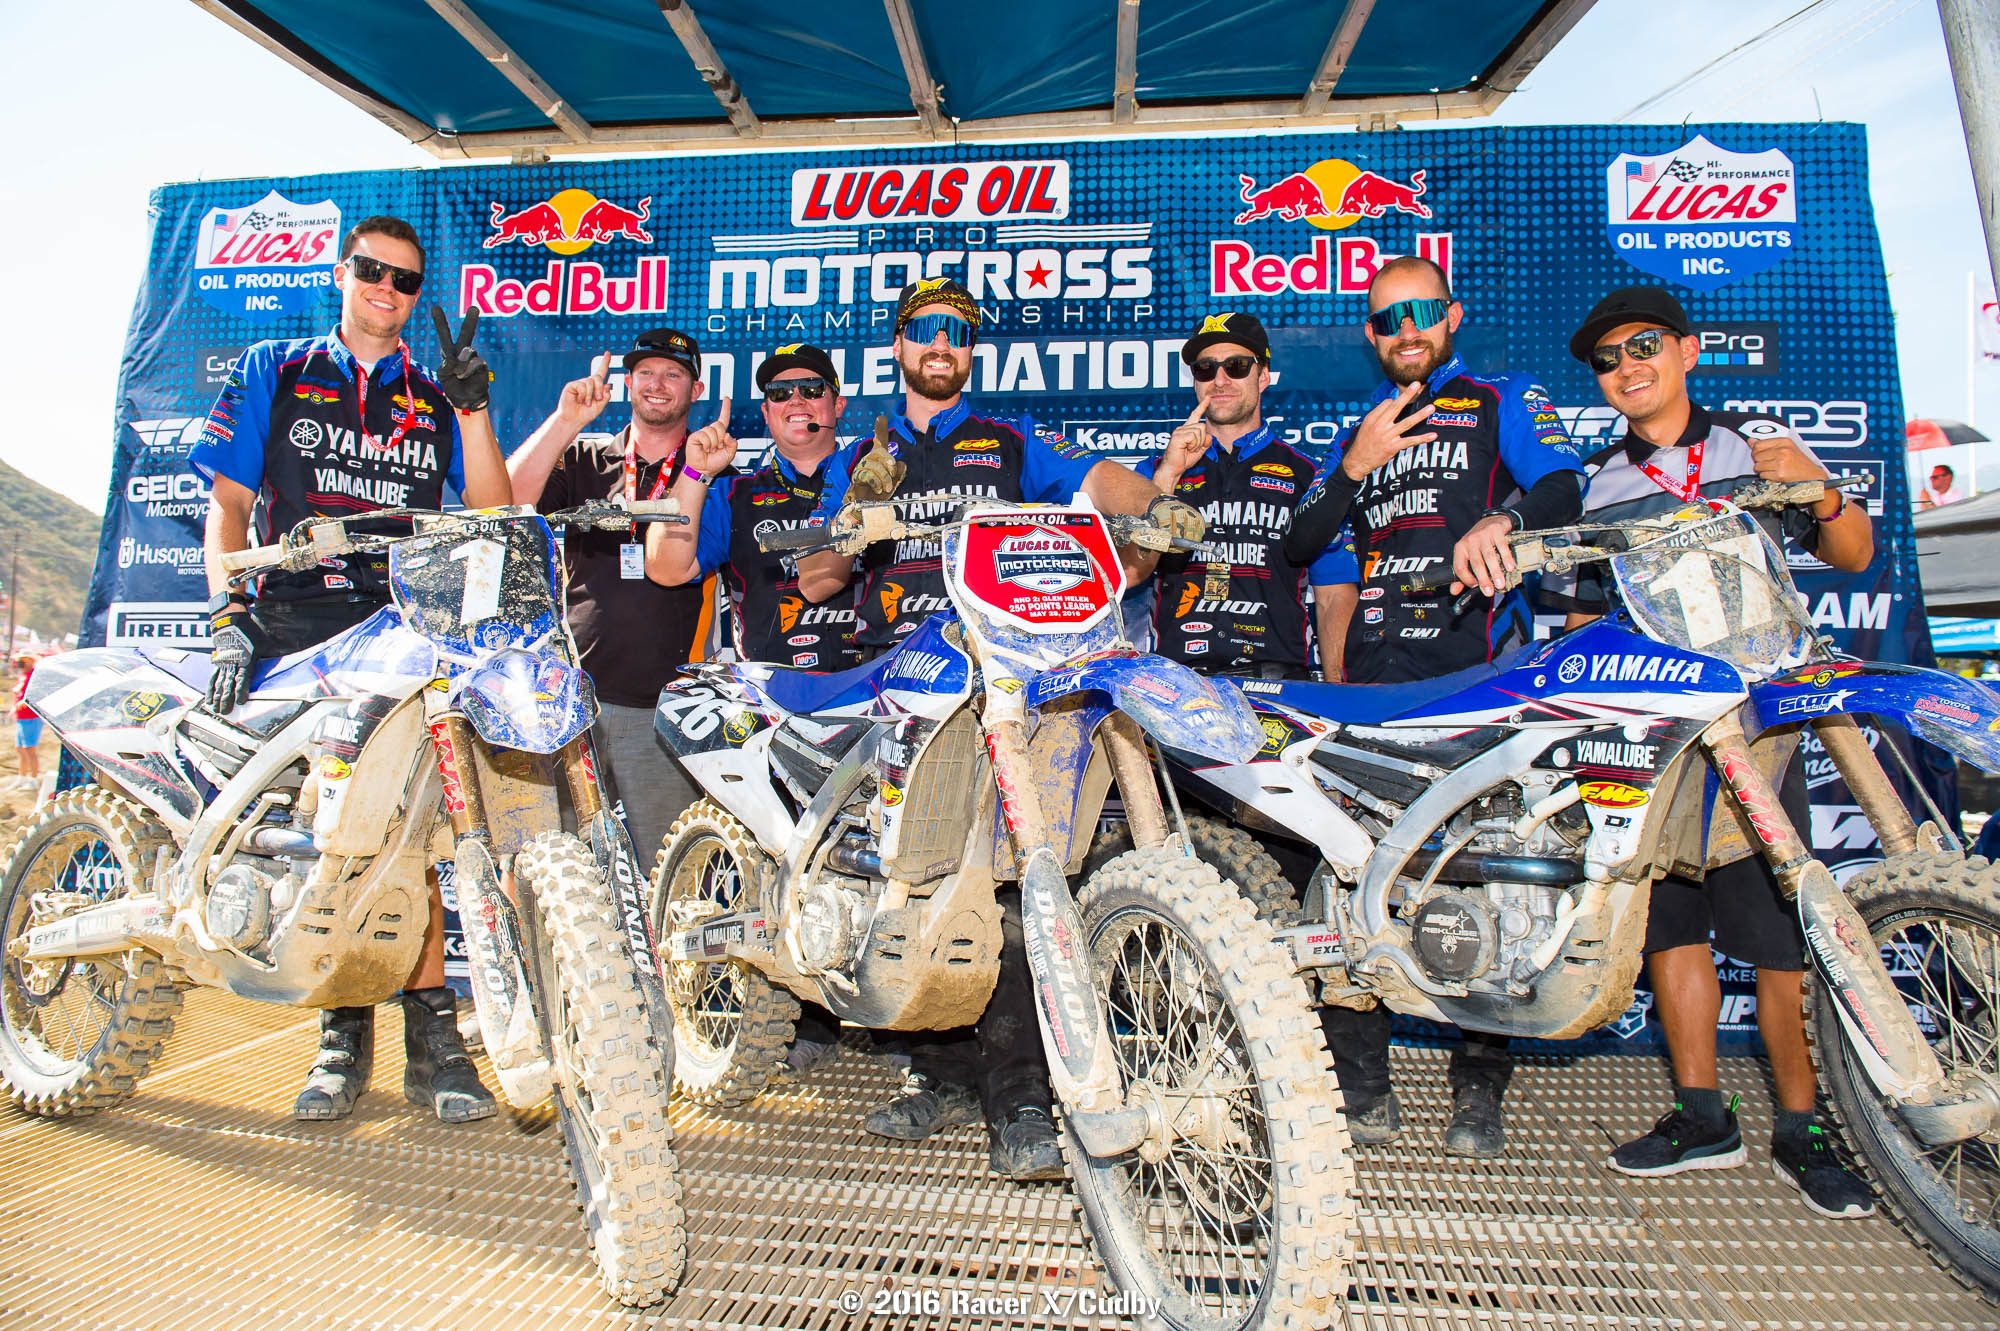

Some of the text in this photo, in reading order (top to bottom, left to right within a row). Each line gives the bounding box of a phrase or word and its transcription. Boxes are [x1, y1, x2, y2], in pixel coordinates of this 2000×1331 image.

[1707, 160, 1722, 168] HI-
[1708, 169, 1791, 179] PERFORMANCE
[802, 160, 1062, 220] LUCAS OIL
[1627, 183, 1787, 221] LUCAS
[276, 217, 338, 228] PERFORMANCE
[209, 229, 334, 265] LUCAS
[869, 227, 986, 245] PRO
[1617, 230, 1792, 249] OIL PRODUCTS
[1213, 237, 1328, 294] Red
[1682, 257, 1730, 275] INC.
[199, 271, 331, 290] OIL PRODUCTS
[461, 257, 668, 316] Red Bull
[708, 246, 1152, 310] MOTOCROSS
[246, 294, 283, 311] INC.
[707, 302, 1154, 333] CHAMPNSHIP
[1701, 332, 1764, 350] Pro
[965, 338, 1282, 393] NATION
[326, 424, 438, 471] YAMAHA
[1076, 427, 1171, 451] Kawas
[1570, 438, 1624, 446] RAC
[300, 450, 429, 480] RACING
[1371, 441, 1469, 488] YAMAHA
[314, 468, 410, 508] YAMALUBE
[146, 502, 210, 519] Motorcyc
[1198, 500, 1290, 530] YAMAHA
[1365, 489, 1438, 529] YAMALUBE
[480, 521, 502, 532] OIL
[1213, 528, 1281, 540] CING
[135, 544, 206, 567] Husqvar
[1010, 540, 1072, 552] LUCAS OIL
[1192, 540, 1267, 566] AMALUBE
[1000, 559, 1088, 571] MOTOCROSS
[1370, 555, 1445, 578] thor
[449, 536, 507, 626] 1
[1649, 533, 1772, 650] 17
[902, 593, 954, 613] tho
[1009, 602, 1097, 612] 250 POINTS LEADER
[800, 607, 855, 625] tho
[897, 650, 951, 684] YAMAHA
[1590, 655, 1705, 685] YAMAHA
[1242, 680, 1283, 695] YAMAHA
[659, 687, 731, 741] 26
[1914, 698, 1980, 723] ESCONDIDO
[1939, 698, 1971, 711] TOYOTA
[1577, 740, 1656, 769] YAMALUBE
[1580, 785, 1648, 803] FMF
[1307, 934, 1341, 944] BRAK
[1422, 926, 1478, 937] REKLUSE
[1024, 911, 1049, 979] YAMALUBE
[1806, 922, 1850, 987] YAMALUBE
[1032, 888, 1095, 1049] DUNLOP
[1718, 968, 1758, 982] AKES
[1041, 983, 1070, 1057] BRAKING
